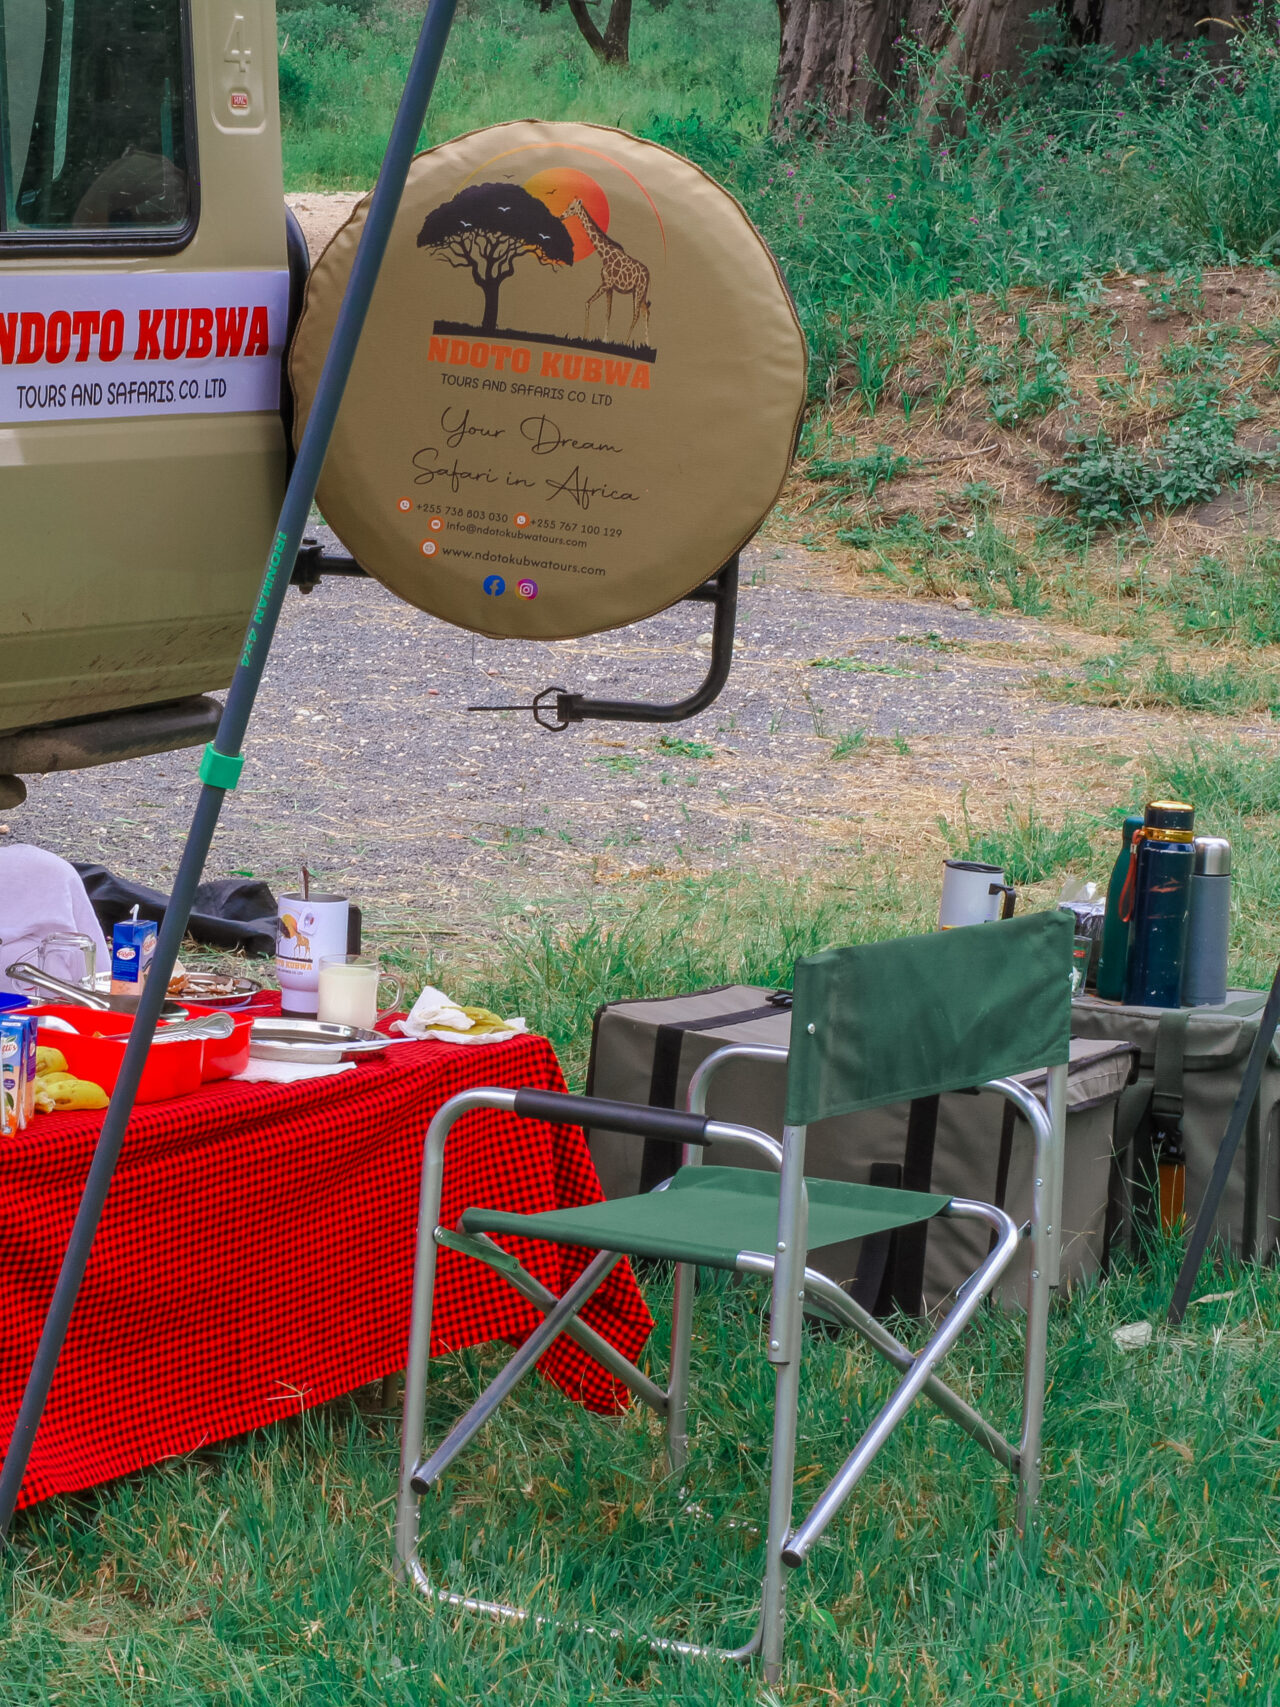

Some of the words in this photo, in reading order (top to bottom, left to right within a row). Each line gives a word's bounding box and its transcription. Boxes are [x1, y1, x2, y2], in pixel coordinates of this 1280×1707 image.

[133, 305, 269, 361] KUBWA
[427, 335, 531, 374] NDOTO
[540, 351, 651, 390] KUBWA
[17, 384, 67, 408] TOURS
[71, 383, 103, 406] AND
[204, 378, 227, 398] LTD
[440, 373, 480, 389] TOURS
[482, 379, 507, 393] AND
[510, 382, 565, 401] SAFARIS
[567, 390, 586, 403] CO
[591, 393, 613, 406] LTD
[441, 406, 505, 448] Your
[520, 414, 623, 455] Dream
[412, 447, 498, 493] Safari
[506, 470, 536, 488] in
[545, 465, 640, 510] Africa
[416, 503, 442, 514] +255
[445, 505, 464, 517] 738
[488, 511, 508, 523] 030
[531, 518, 556, 530] +255
[560, 521, 578, 532] 767
[581, 524, 600, 536] 100
[603, 527, 623, 538] 129
[253, 530, 288, 625] IRONMAN
[442, 547, 606, 576] www.ndotokubwatours.com
